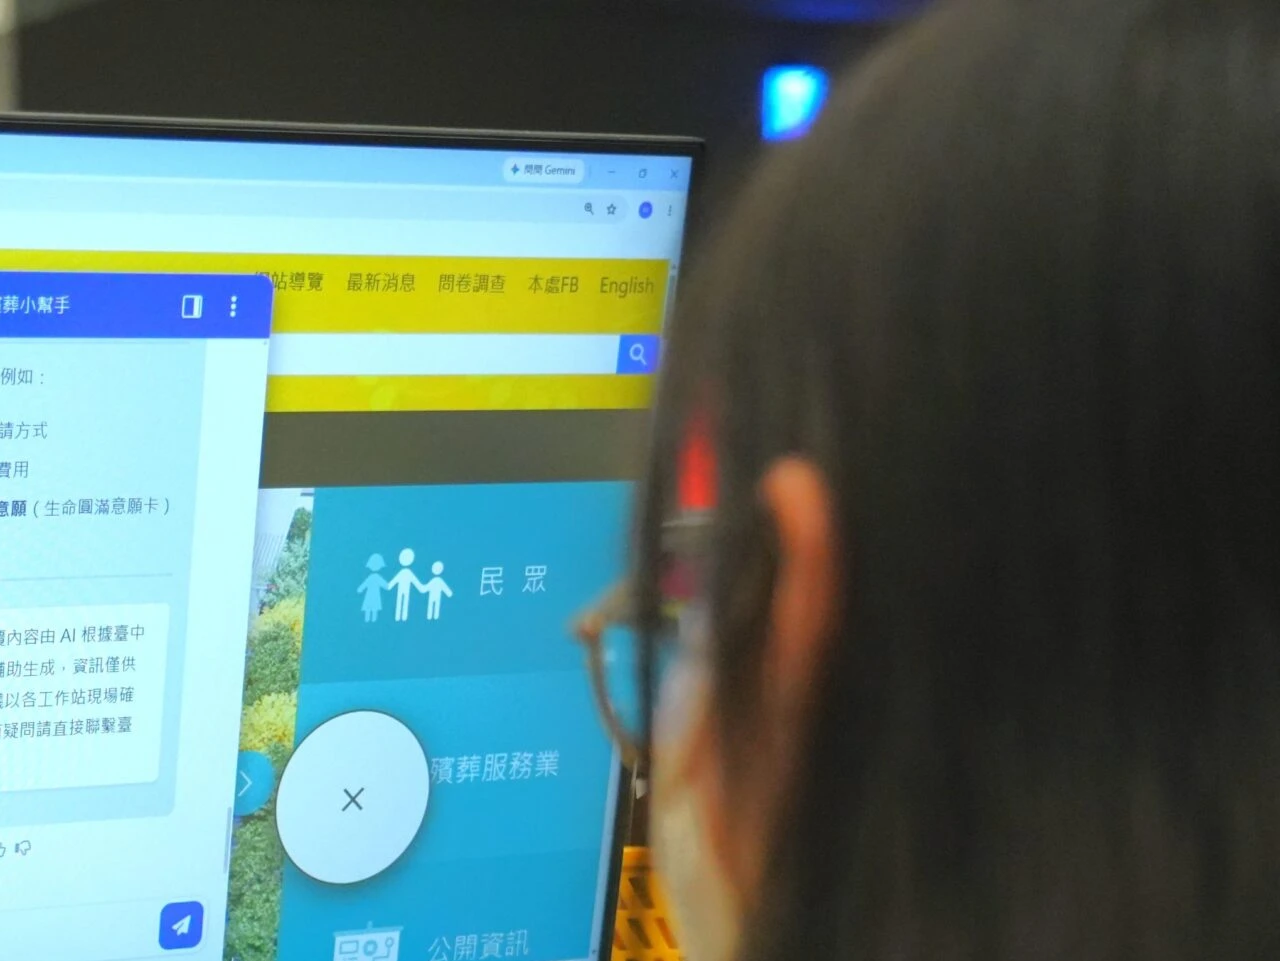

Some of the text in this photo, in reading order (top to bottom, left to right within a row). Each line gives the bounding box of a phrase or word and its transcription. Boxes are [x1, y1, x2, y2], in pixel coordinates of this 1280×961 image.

[545, 164, 576, 175] Gemini
[347, 272, 416, 293] 最新消息
[439, 273, 506, 294] 問卷調查
[528, 274, 580, 294] 本處FB
[600, 276, 654, 299] English
[60, 628, 76, 643] AI
[81, 625, 146, 643] 根據臺中
[431, 749, 560, 785] 殯葬服務業
